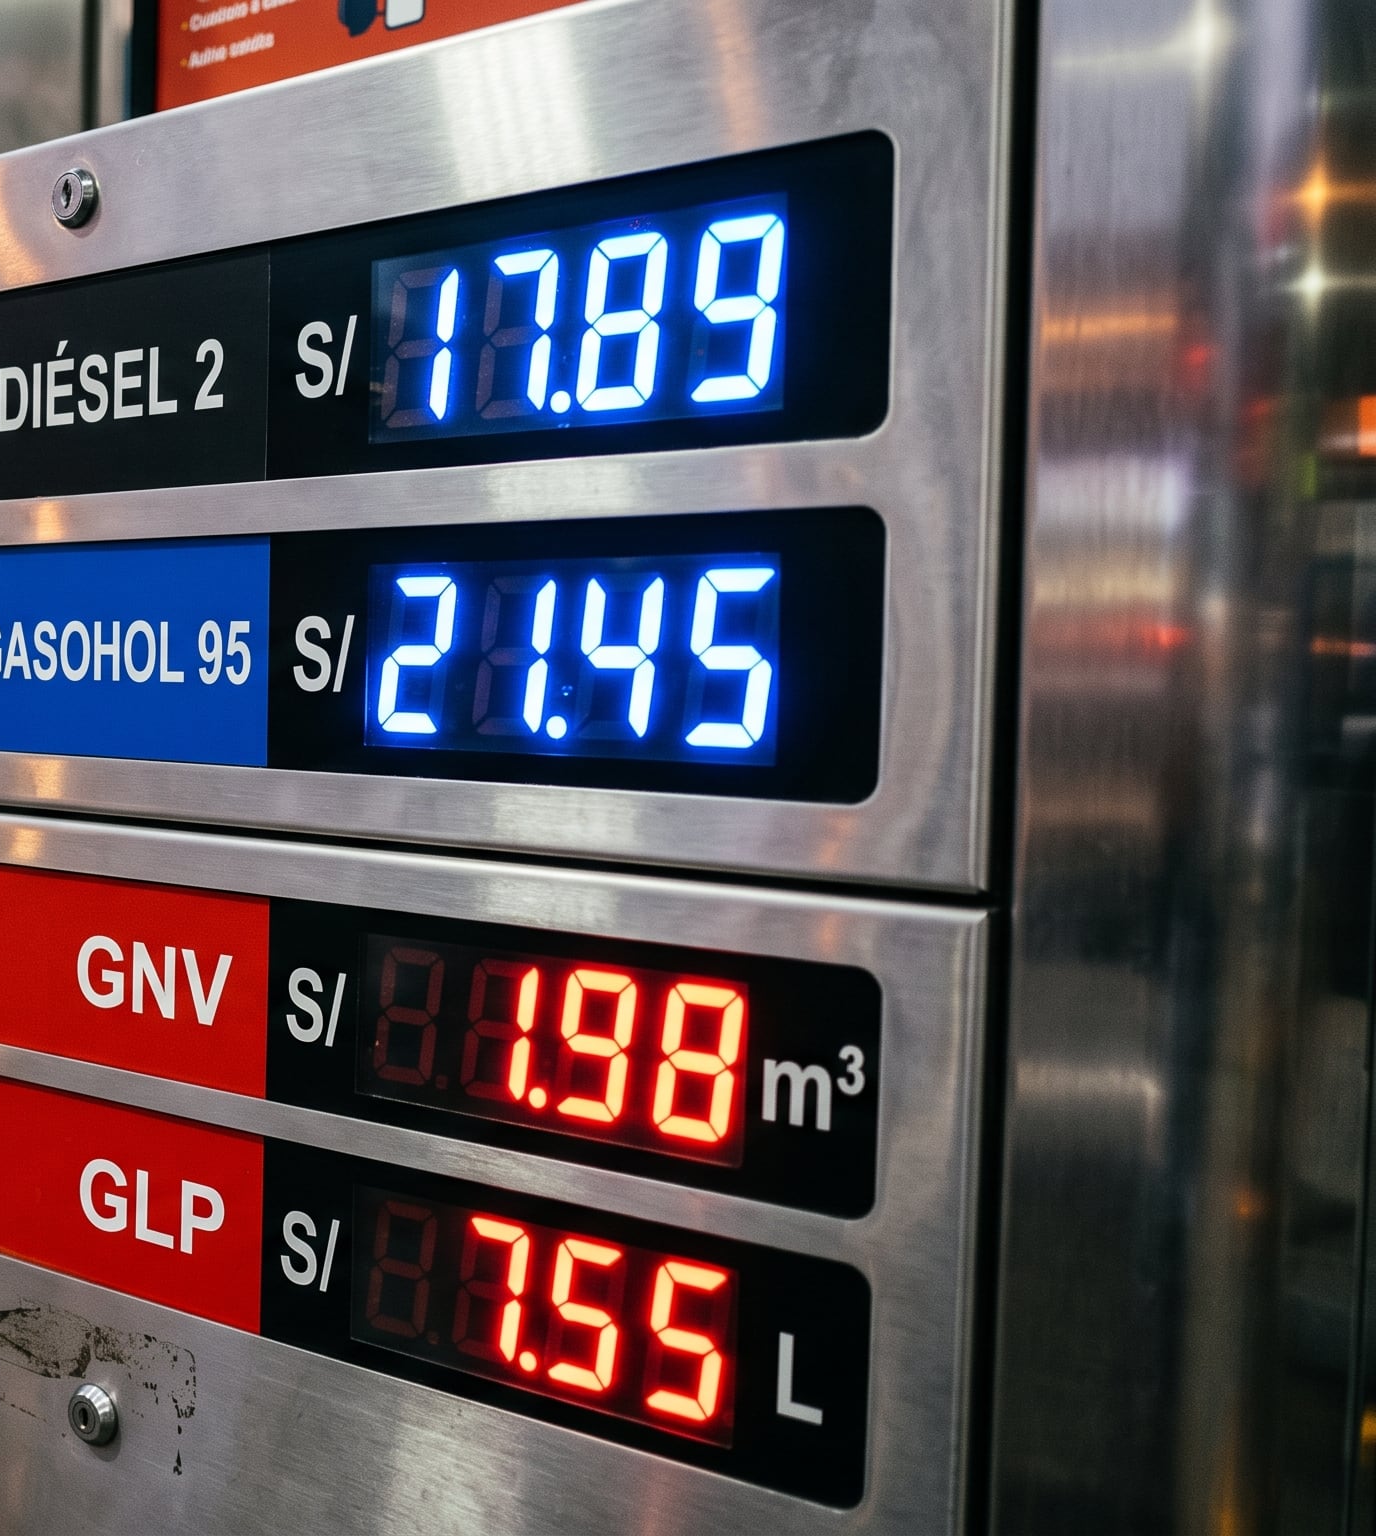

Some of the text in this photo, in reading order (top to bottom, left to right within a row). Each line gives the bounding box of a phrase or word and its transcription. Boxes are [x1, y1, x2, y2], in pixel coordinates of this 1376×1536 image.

[194, 338, 224, 411] 2
[295, 213, 785, 421] S/ 17.89
[198, 620, 251, 685] 95
[293, 567, 775, 749] S/ 21.45
[76, 935, 233, 1026] GNV
[285, 967, 347, 1047] S/
[509, 966, 744, 1142] 1.98
[79, 1158, 225, 1255] GLP
[280, 1210, 823, 1425] S/ 7.55 L
